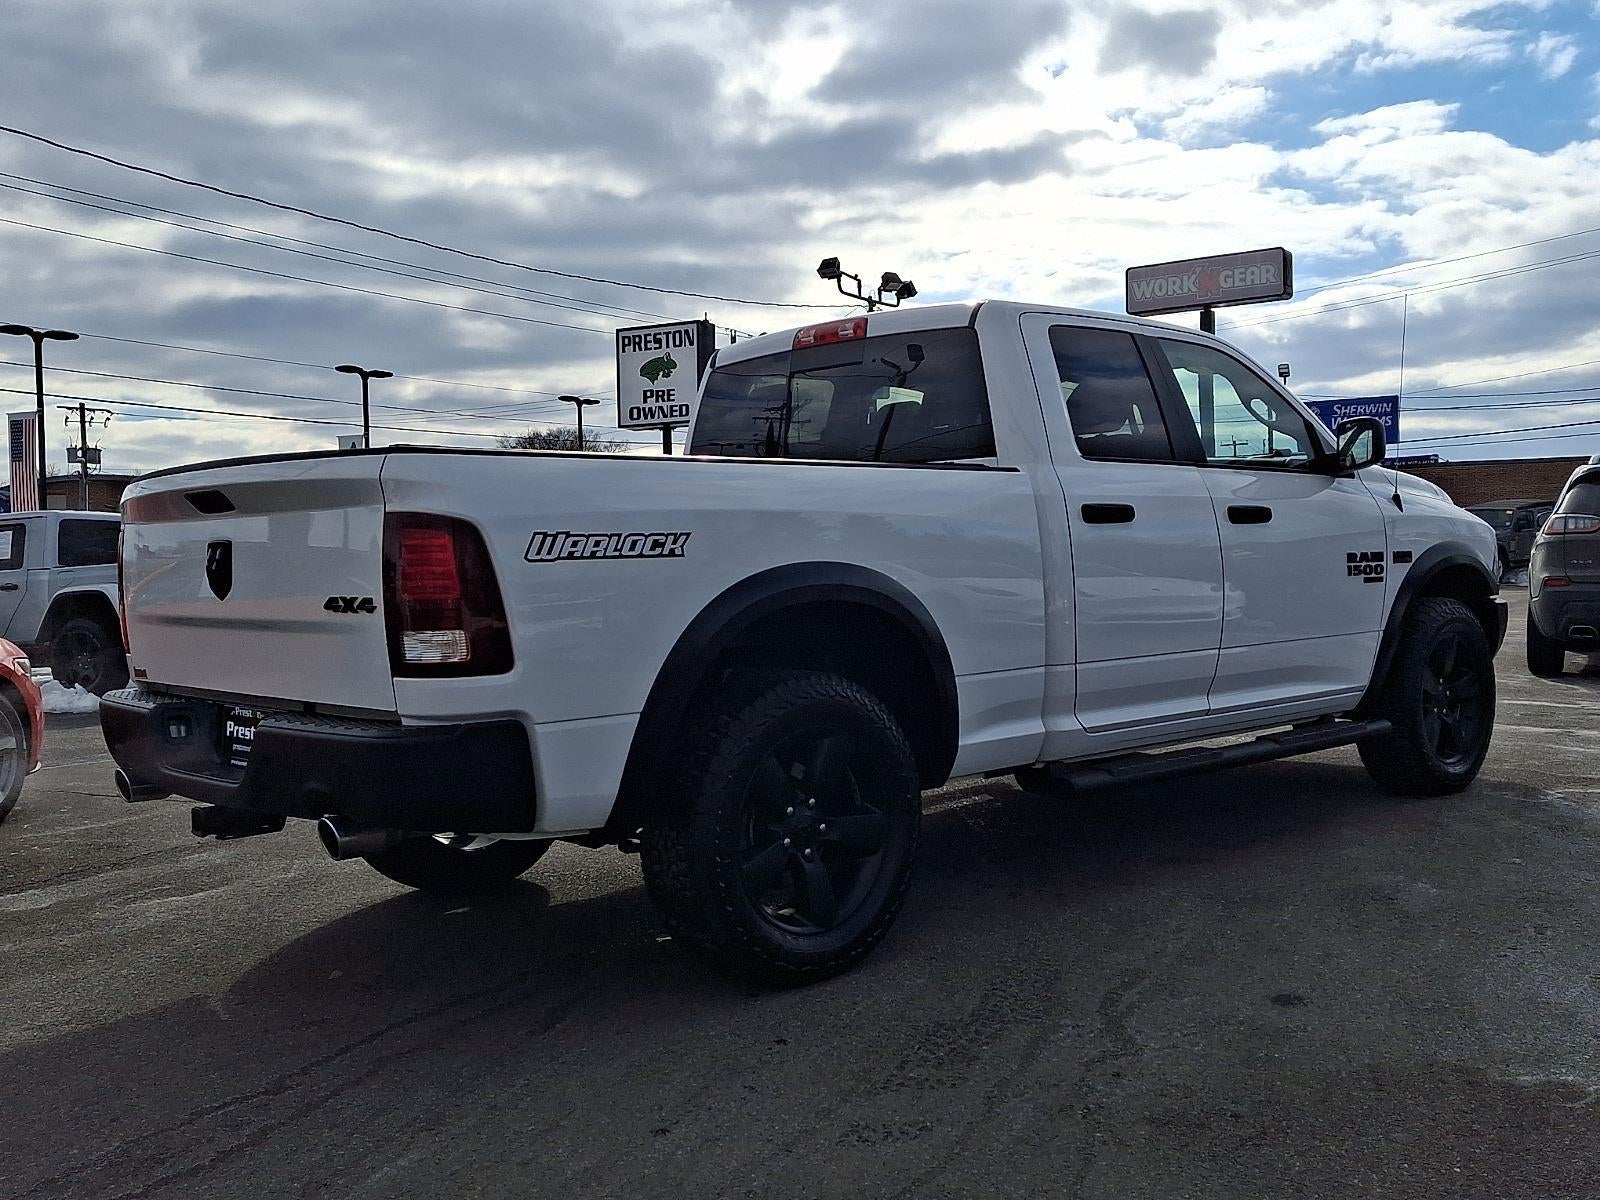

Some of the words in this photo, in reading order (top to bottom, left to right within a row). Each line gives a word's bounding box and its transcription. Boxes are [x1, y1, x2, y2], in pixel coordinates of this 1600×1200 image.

[1131, 273, 1198, 300] WORK
[1220, 263, 1278, 289] GEAR
[621, 328, 695, 353] PRESTON
[642, 388, 676, 404] PRE
[628, 403, 690, 421] OWNED
[1332, 403, 1392, 417] SHERWIN
[524, 531, 692, 563] WARLOCK
[1346, 551, 1385, 564] RAM
[1346, 564, 1385, 577] 1500
[323, 596, 378, 614] 4X4
[226, 720, 256, 741] Prest
